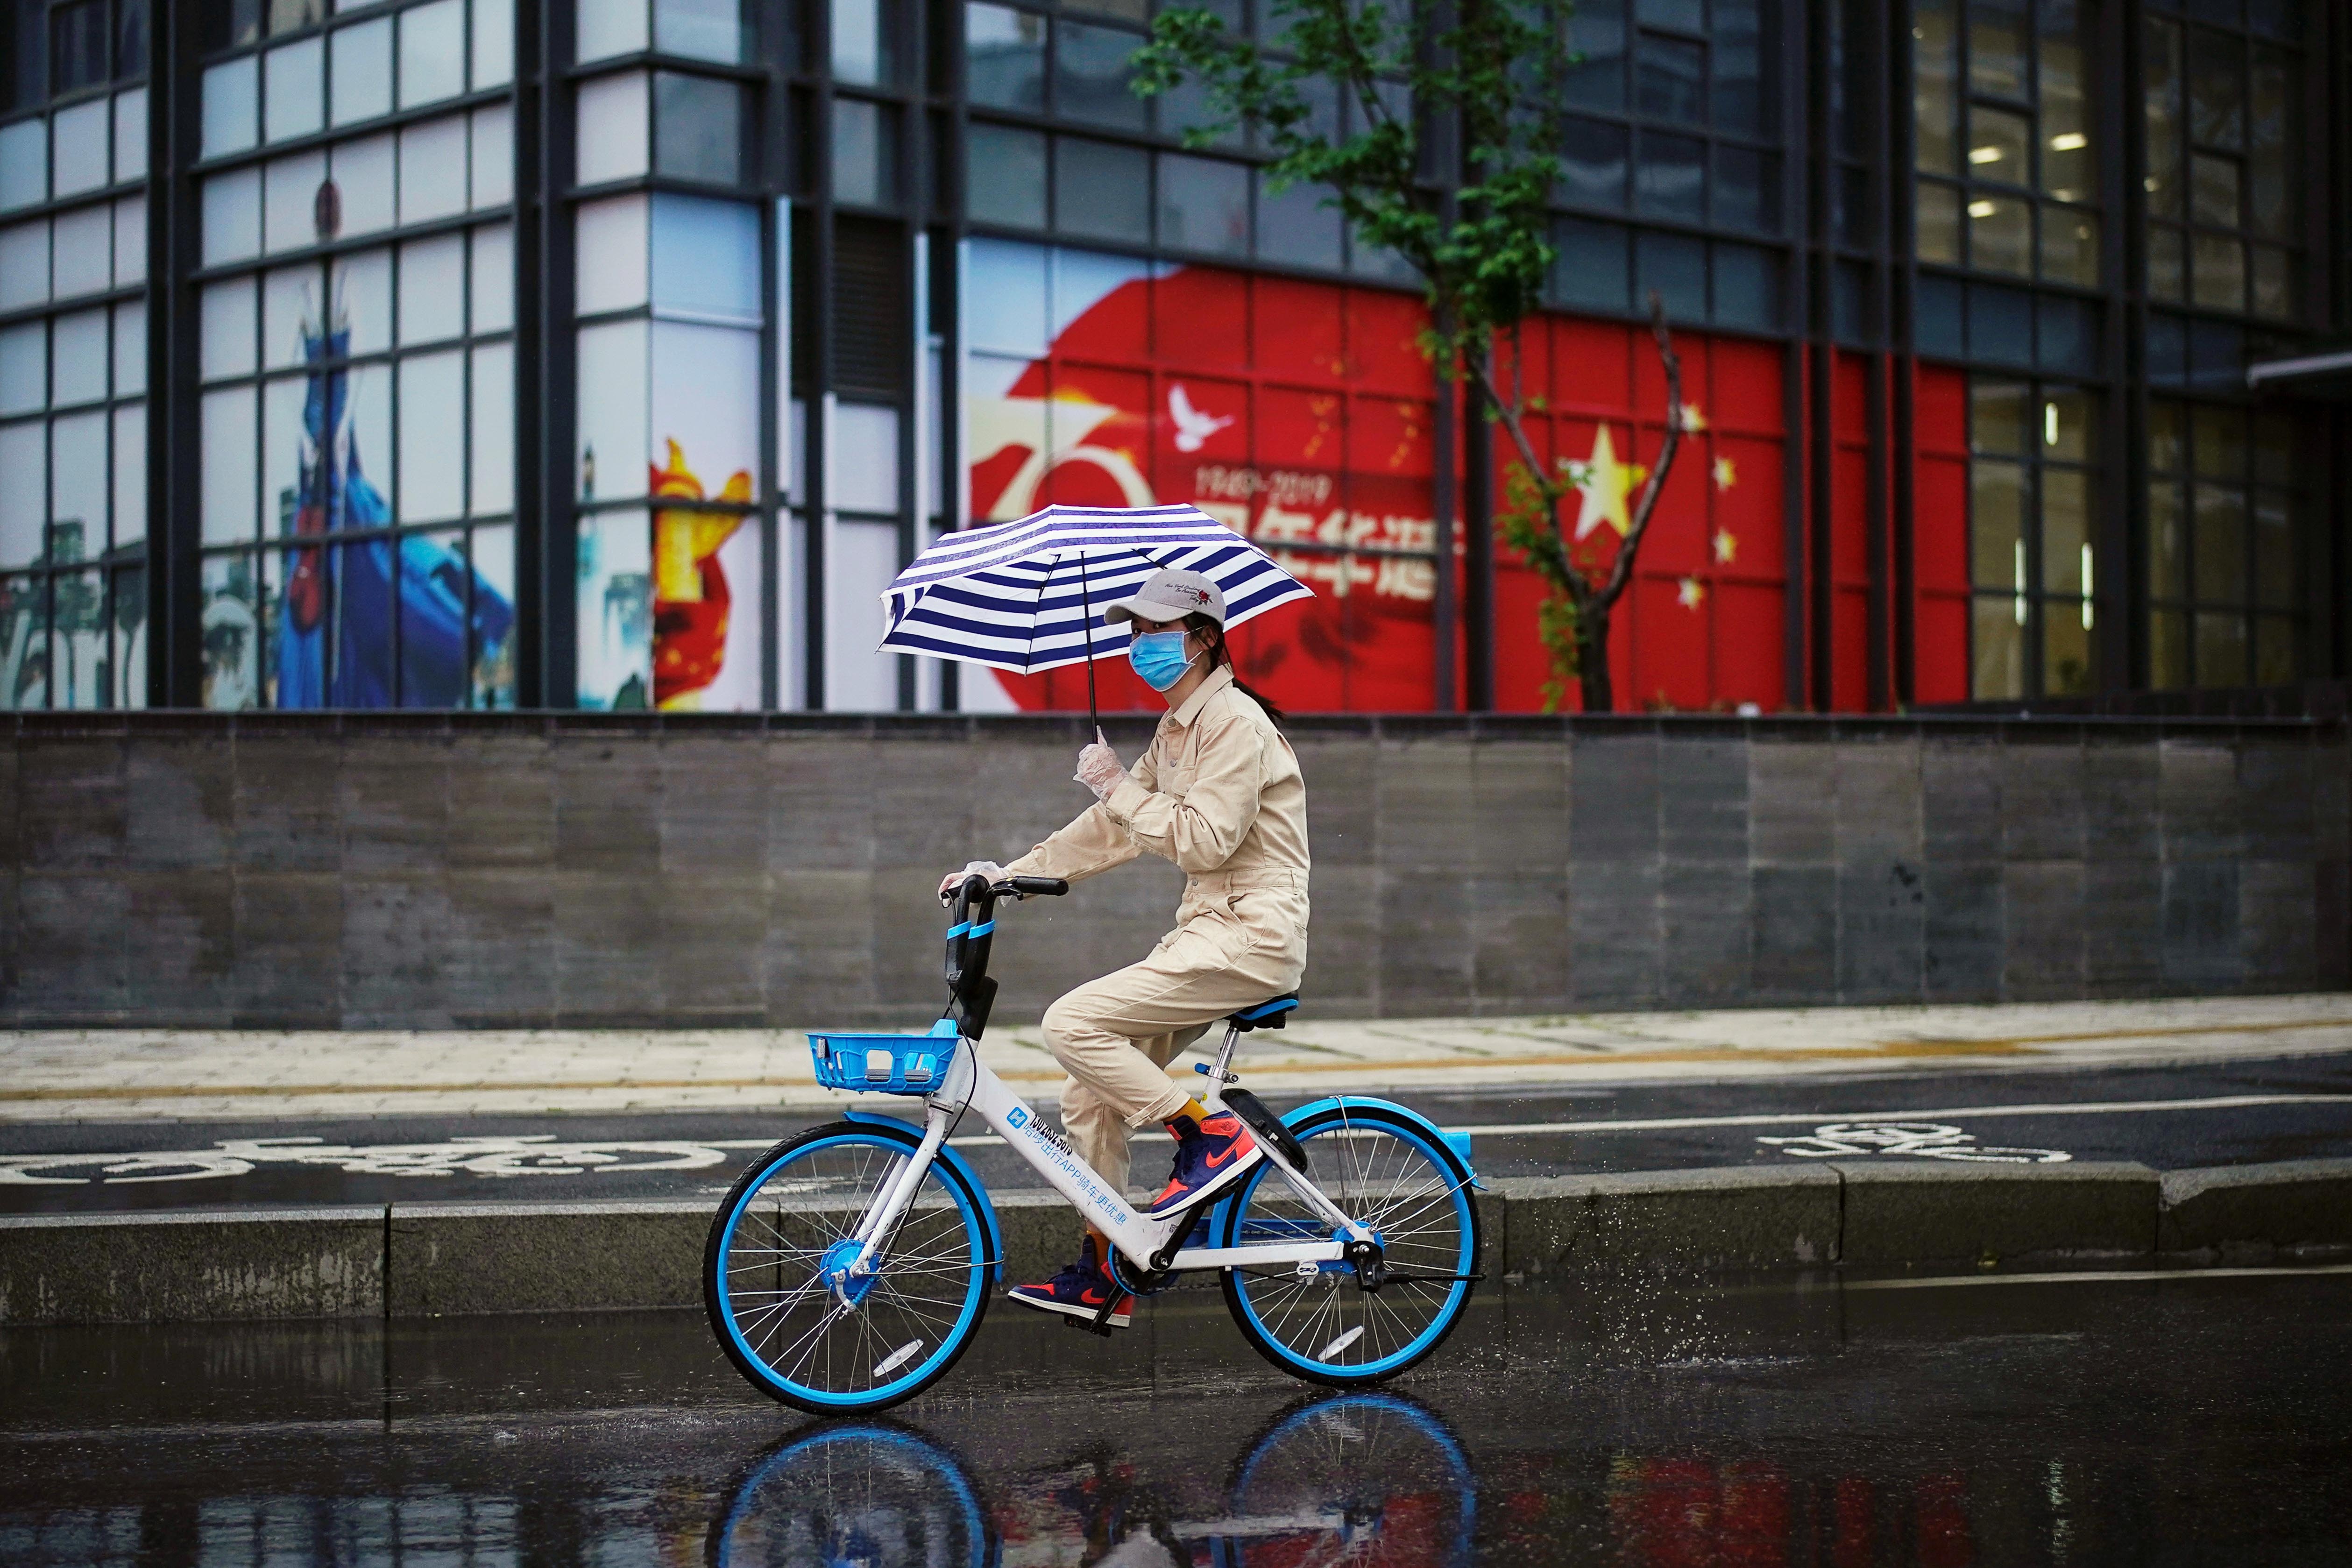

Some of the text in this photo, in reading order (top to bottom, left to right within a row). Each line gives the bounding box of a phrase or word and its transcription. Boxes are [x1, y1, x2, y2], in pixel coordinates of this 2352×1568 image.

[1023, 1121, 1128, 1226] 哈啰出行APP骑车更优惠
